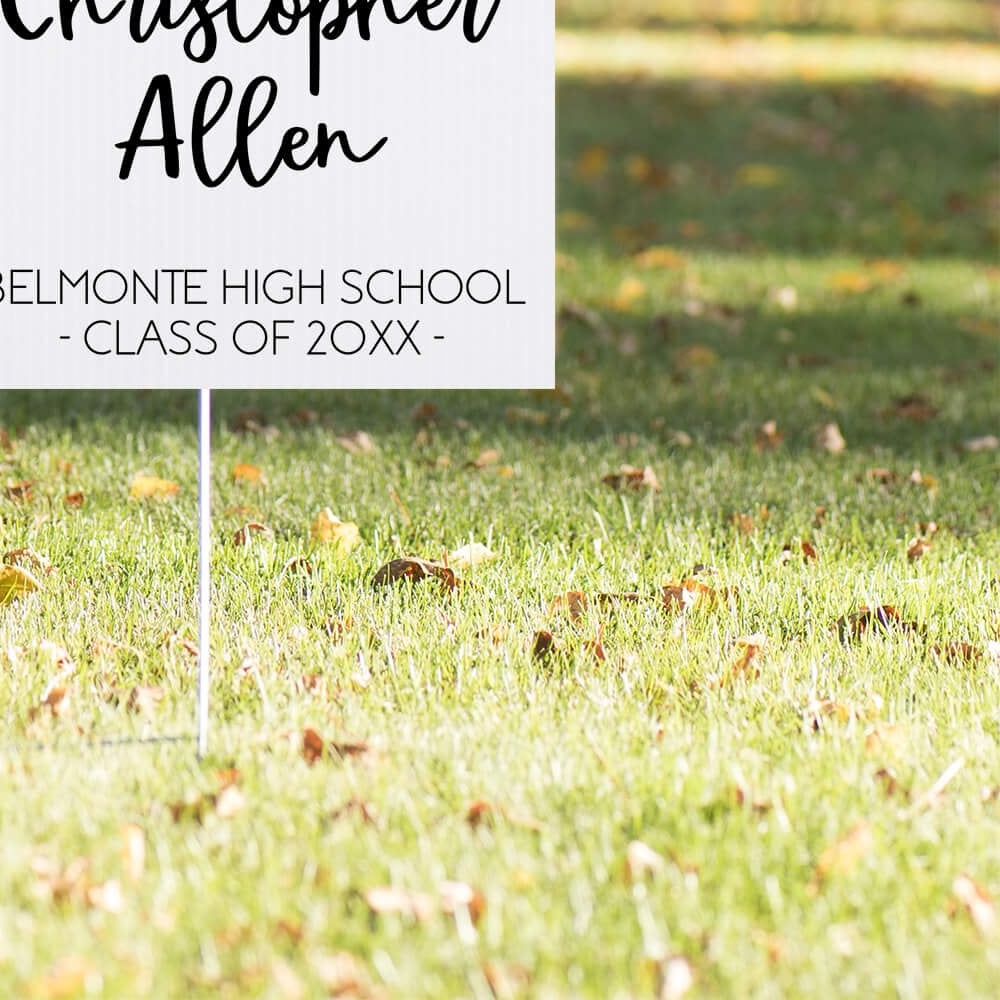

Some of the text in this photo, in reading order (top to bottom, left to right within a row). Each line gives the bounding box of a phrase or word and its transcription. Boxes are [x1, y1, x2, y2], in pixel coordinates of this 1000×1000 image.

[115, 74, 388, 188] Allen
[223, 269, 324, 304] HIGH
[341, 269, 526, 304] SCHOOL
[84, 320, 217, 355] CLASS
[233, 320, 294, 355] OF
